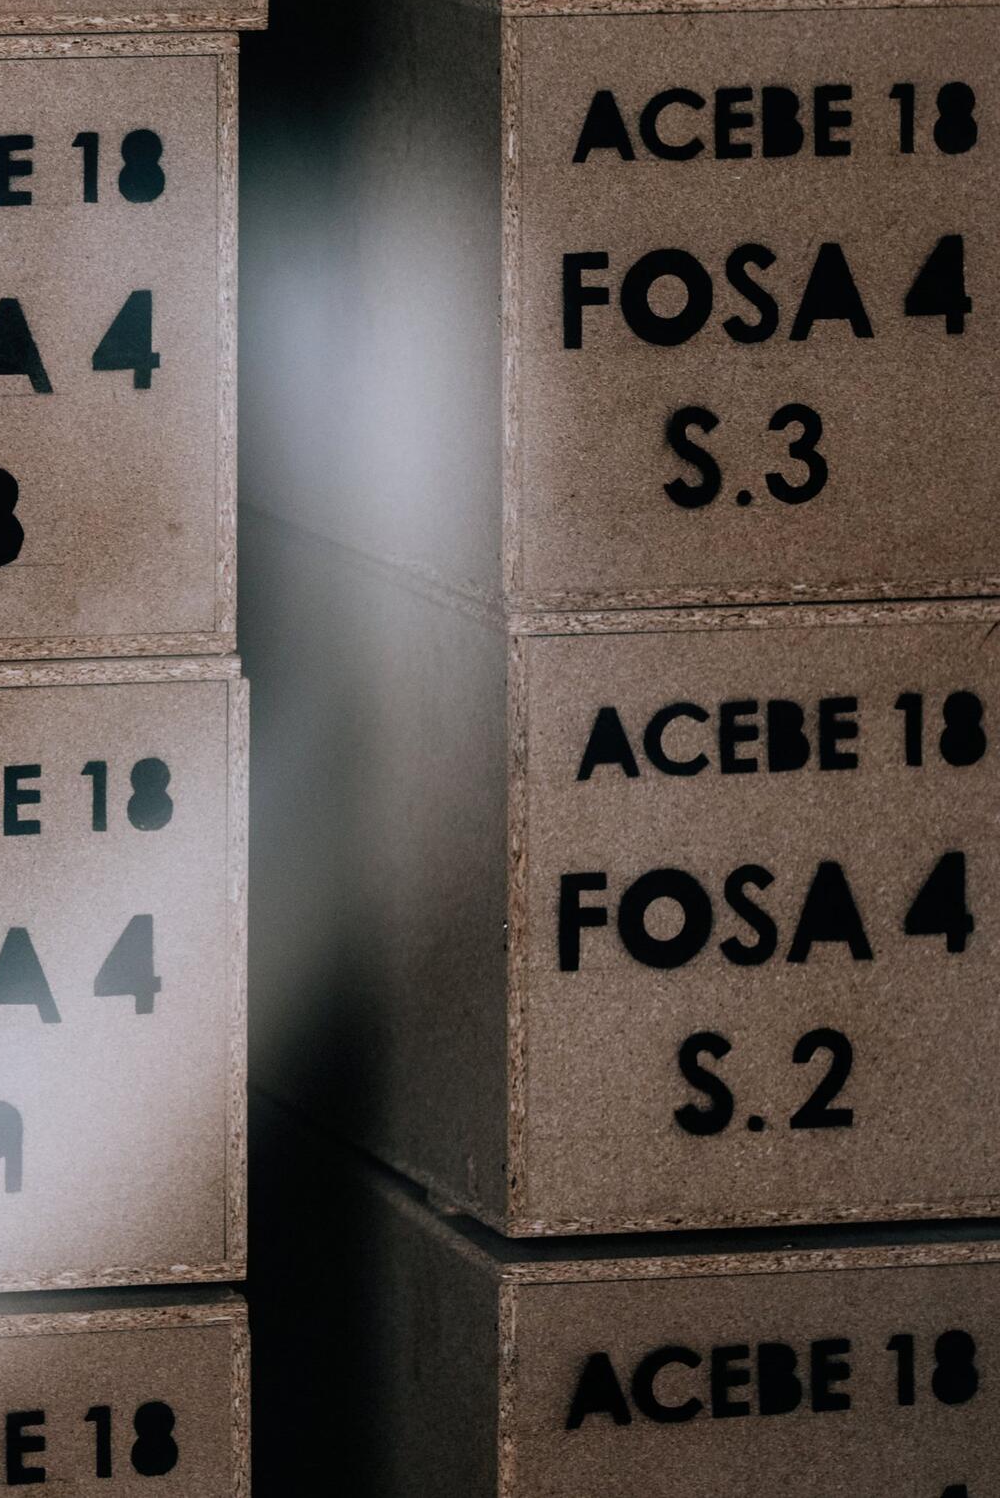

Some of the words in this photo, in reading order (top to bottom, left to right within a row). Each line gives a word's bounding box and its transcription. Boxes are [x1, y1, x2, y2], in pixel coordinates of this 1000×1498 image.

[72, 129, 166, 203] 18
[572, 85, 852, 163] ACEBE
[890, 81, 977, 155] 18
[563, 243, 874, 349] FOSA
[905, 235, 972, 335] 4
[91, 290, 160, 390] 4
[576, 696, 859, 782] ACEBE
[894, 691, 987, 767] 18
[80, 757, 173, 832] 18
[559, 861, 874, 972] FOSA
[904, 851, 974, 953] 4
[93, 914, 162, 1015] 4
[565, 1338, 851, 1430] ACEBE
[887, 1329, 979, 1406] 18
[84, 1401, 179, 1478] 18
